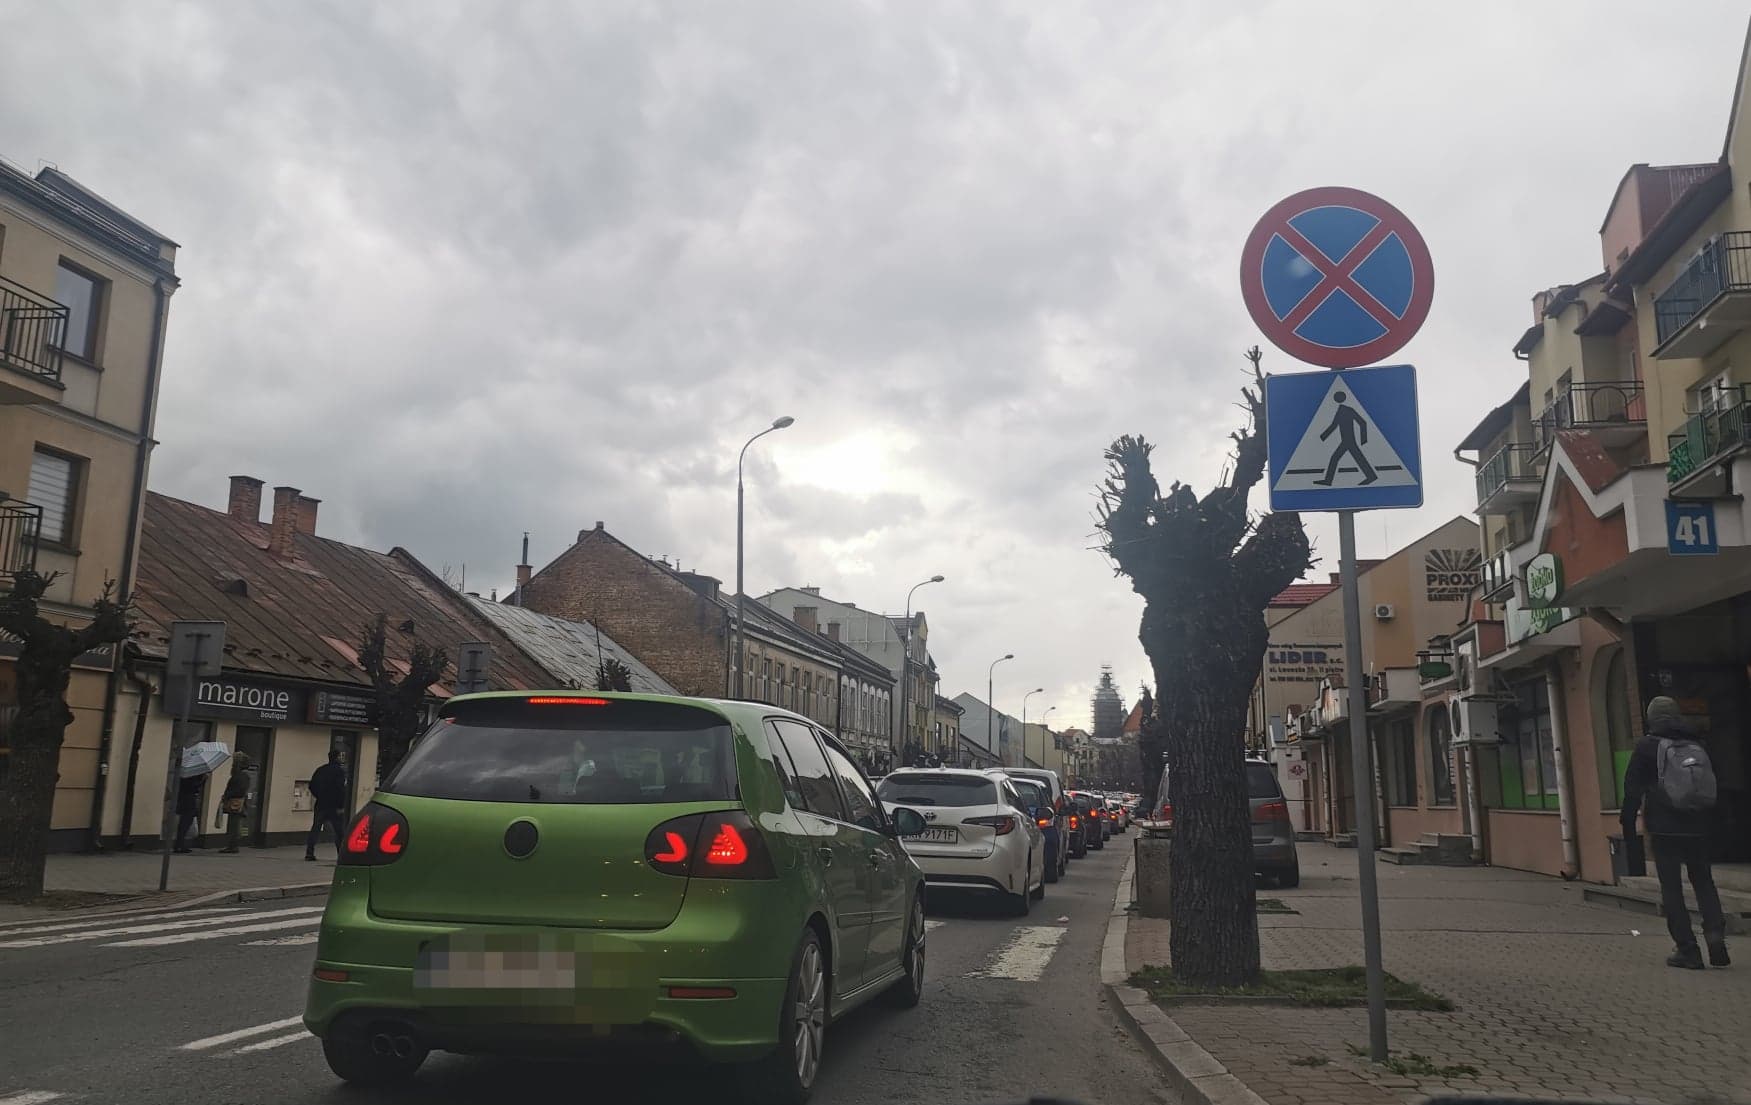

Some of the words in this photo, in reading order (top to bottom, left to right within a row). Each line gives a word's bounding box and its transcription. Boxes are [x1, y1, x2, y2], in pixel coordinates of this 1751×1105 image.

[1675, 515, 1710, 546] 41
[1269, 651, 1328, 664] LIDER
[198, 681, 289, 709] marone
[260, 711, 287, 720] boutique
[924, 829, 954, 840] 9171F
